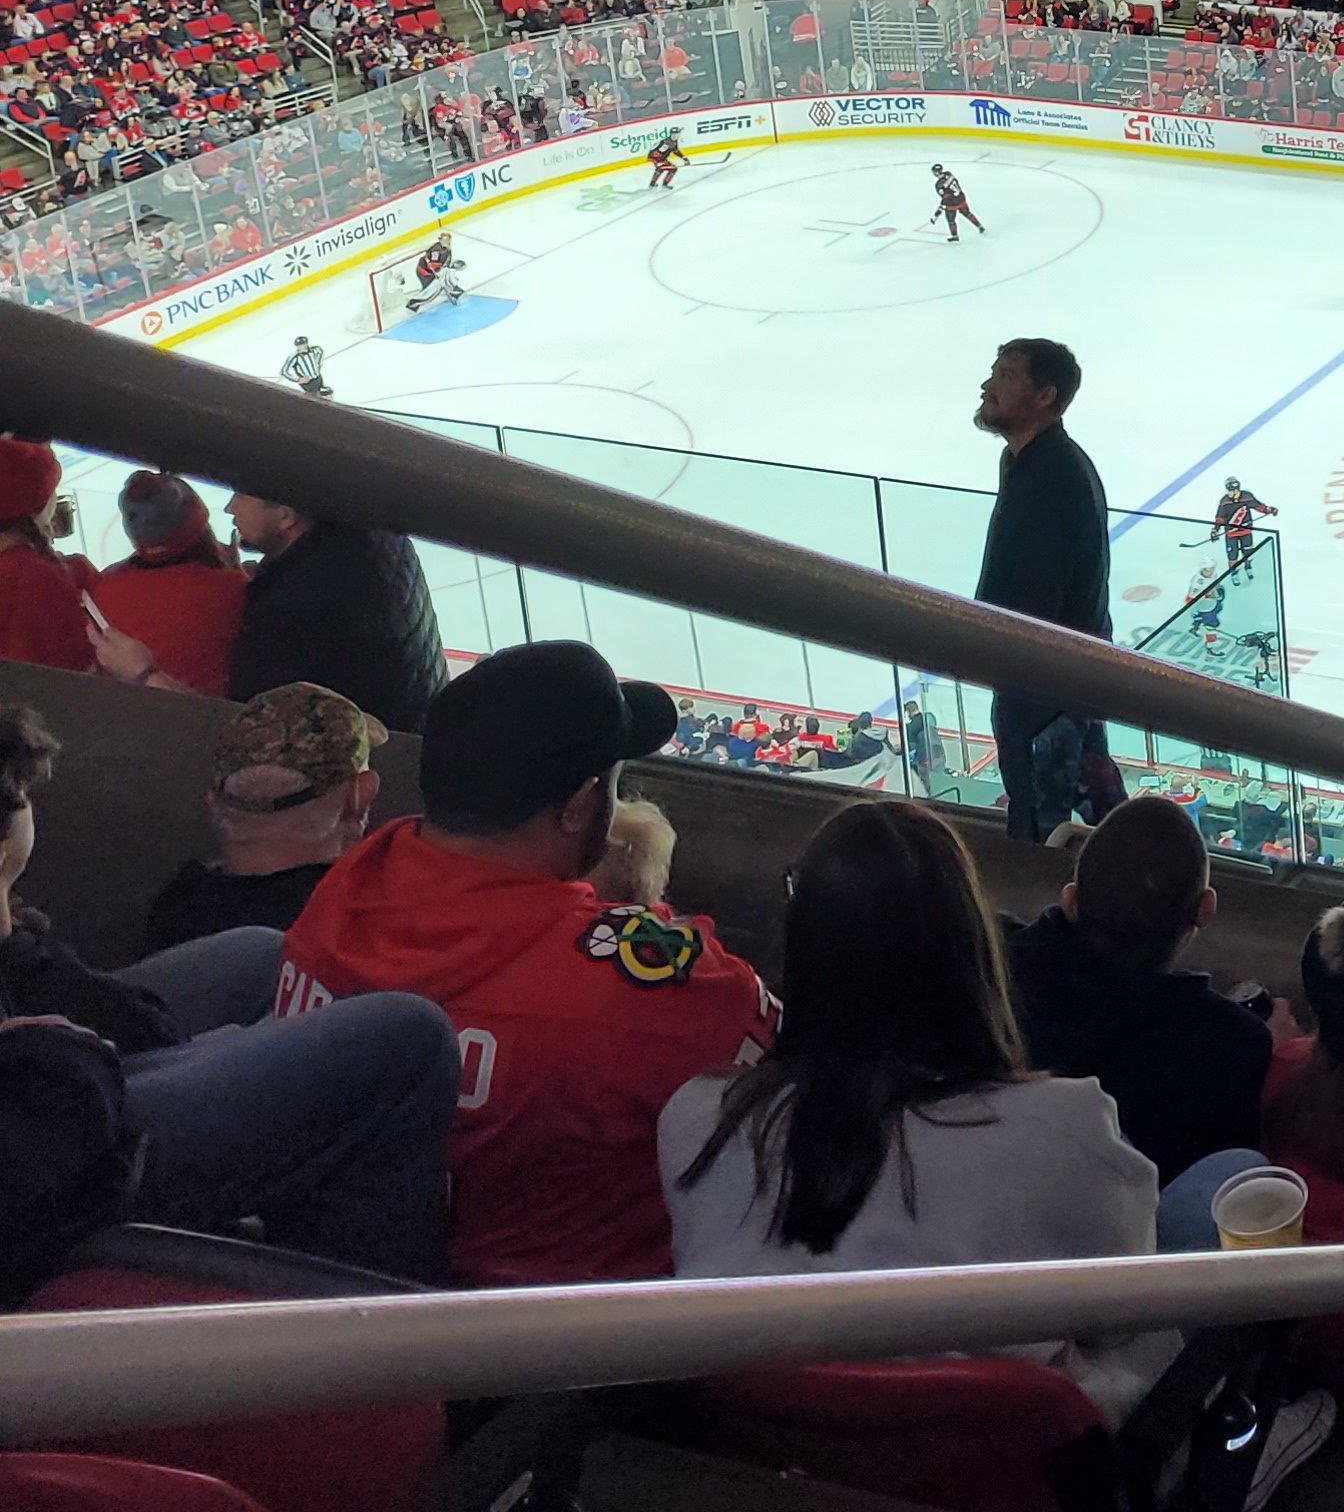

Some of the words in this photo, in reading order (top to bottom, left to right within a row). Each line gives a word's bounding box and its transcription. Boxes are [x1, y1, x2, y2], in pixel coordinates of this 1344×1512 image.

[836, 97, 926, 112] VECTOR
[838, 112, 927, 126] SECURITY
[1151, 116, 1215, 135] CLANCY
[1151, 130, 1216, 149] &THEYS
[1275, 131, 1324, 149] Harris
[482, 164, 513, 189] NC
[314, 211, 398, 257] invisalign
